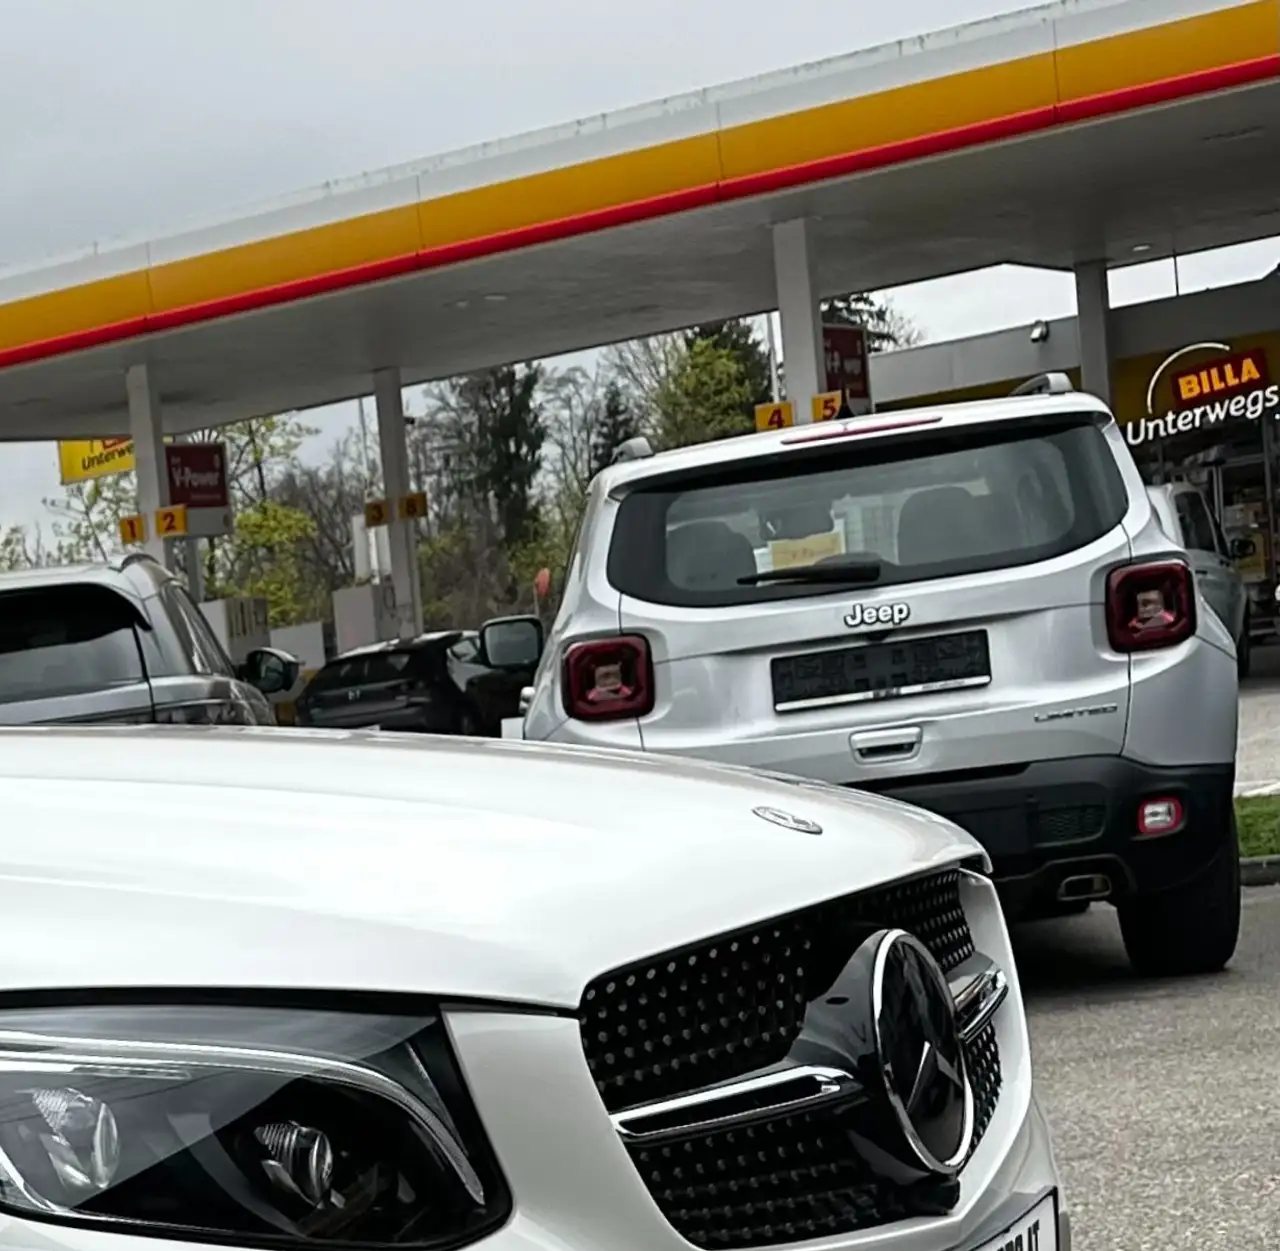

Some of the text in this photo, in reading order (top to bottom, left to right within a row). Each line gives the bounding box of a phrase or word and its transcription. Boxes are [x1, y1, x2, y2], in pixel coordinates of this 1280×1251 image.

[1178, 357, 1260, 400] BILLA
[767, 408, 785, 428] 4
[822, 398, 837, 421] 5
[1126, 384, 1280, 445] Unterwegs
[126, 519, 137, 539] 1
[162, 511, 176, 532] 2
[844, 601, 910, 628] Jeep
[1033, 702, 1118, 723] LIMITED
